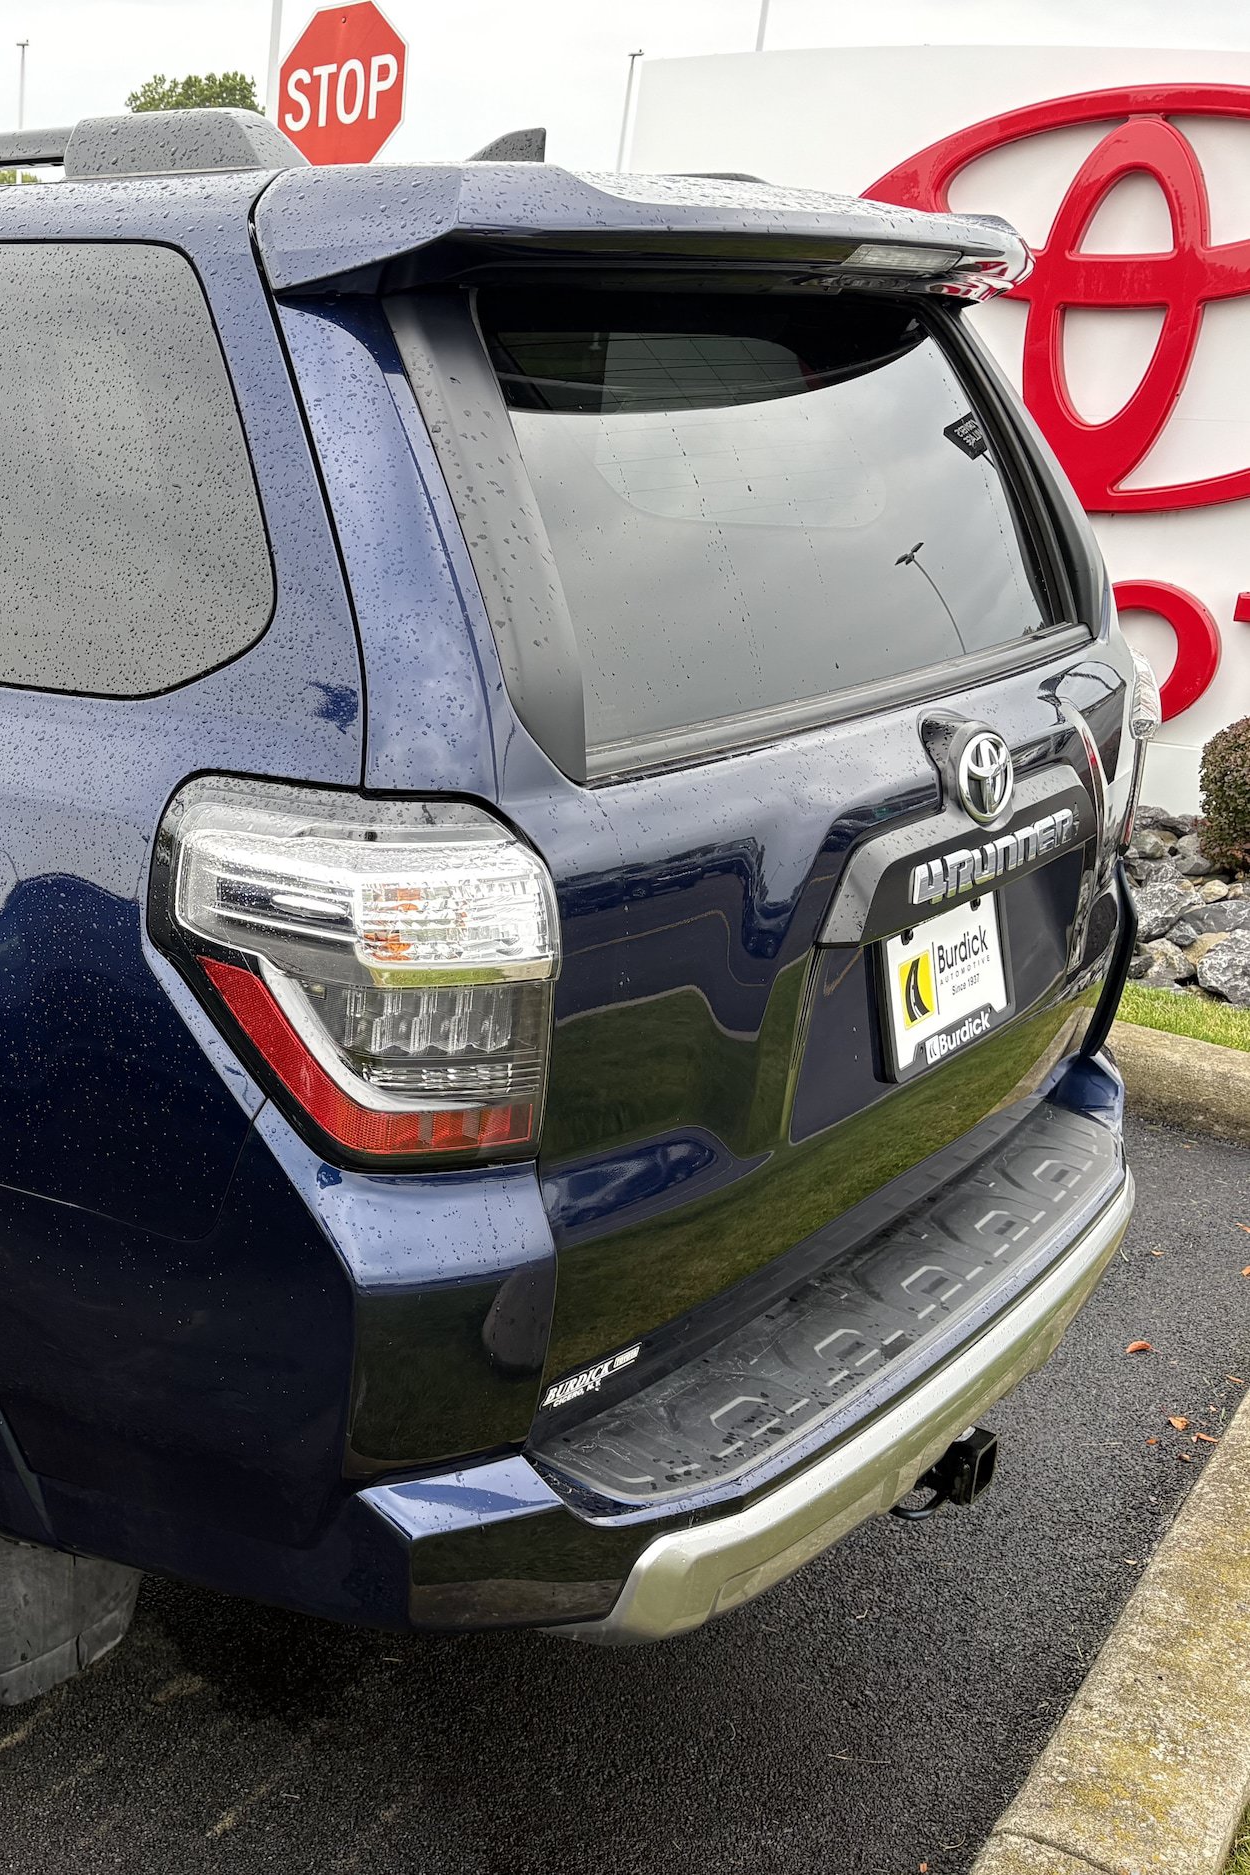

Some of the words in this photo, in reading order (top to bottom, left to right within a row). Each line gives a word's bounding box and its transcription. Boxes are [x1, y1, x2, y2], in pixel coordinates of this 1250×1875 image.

[284, 53, 398, 132] STOP
[937, 925, 989, 974] Burdick
[939, 954, 991, 986] AUTOMOTIVE
[951, 981, 967, 996] Since
[967, 973, 981, 988] 1937
[938, 1010, 991, 1056] Burdick
[545, 1360, 614, 1402] BURDICK
